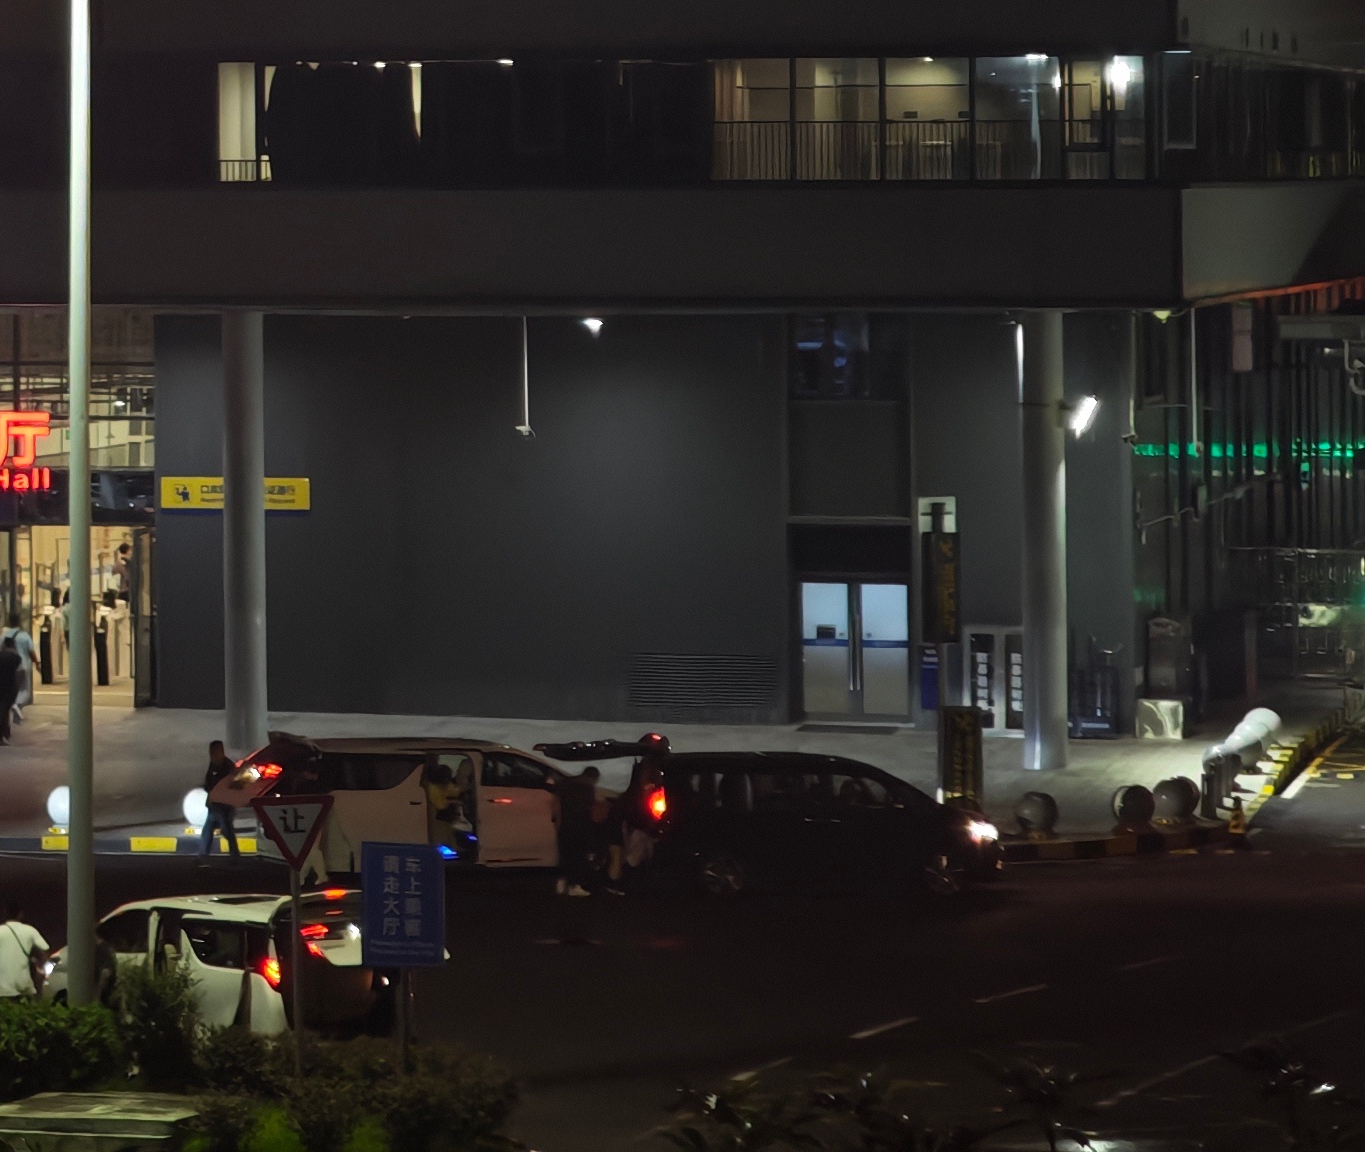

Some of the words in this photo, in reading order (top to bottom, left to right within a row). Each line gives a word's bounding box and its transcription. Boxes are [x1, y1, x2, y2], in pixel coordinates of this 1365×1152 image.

[279, 808, 307, 834] 让
[382, 855, 401, 936] 走大厅
